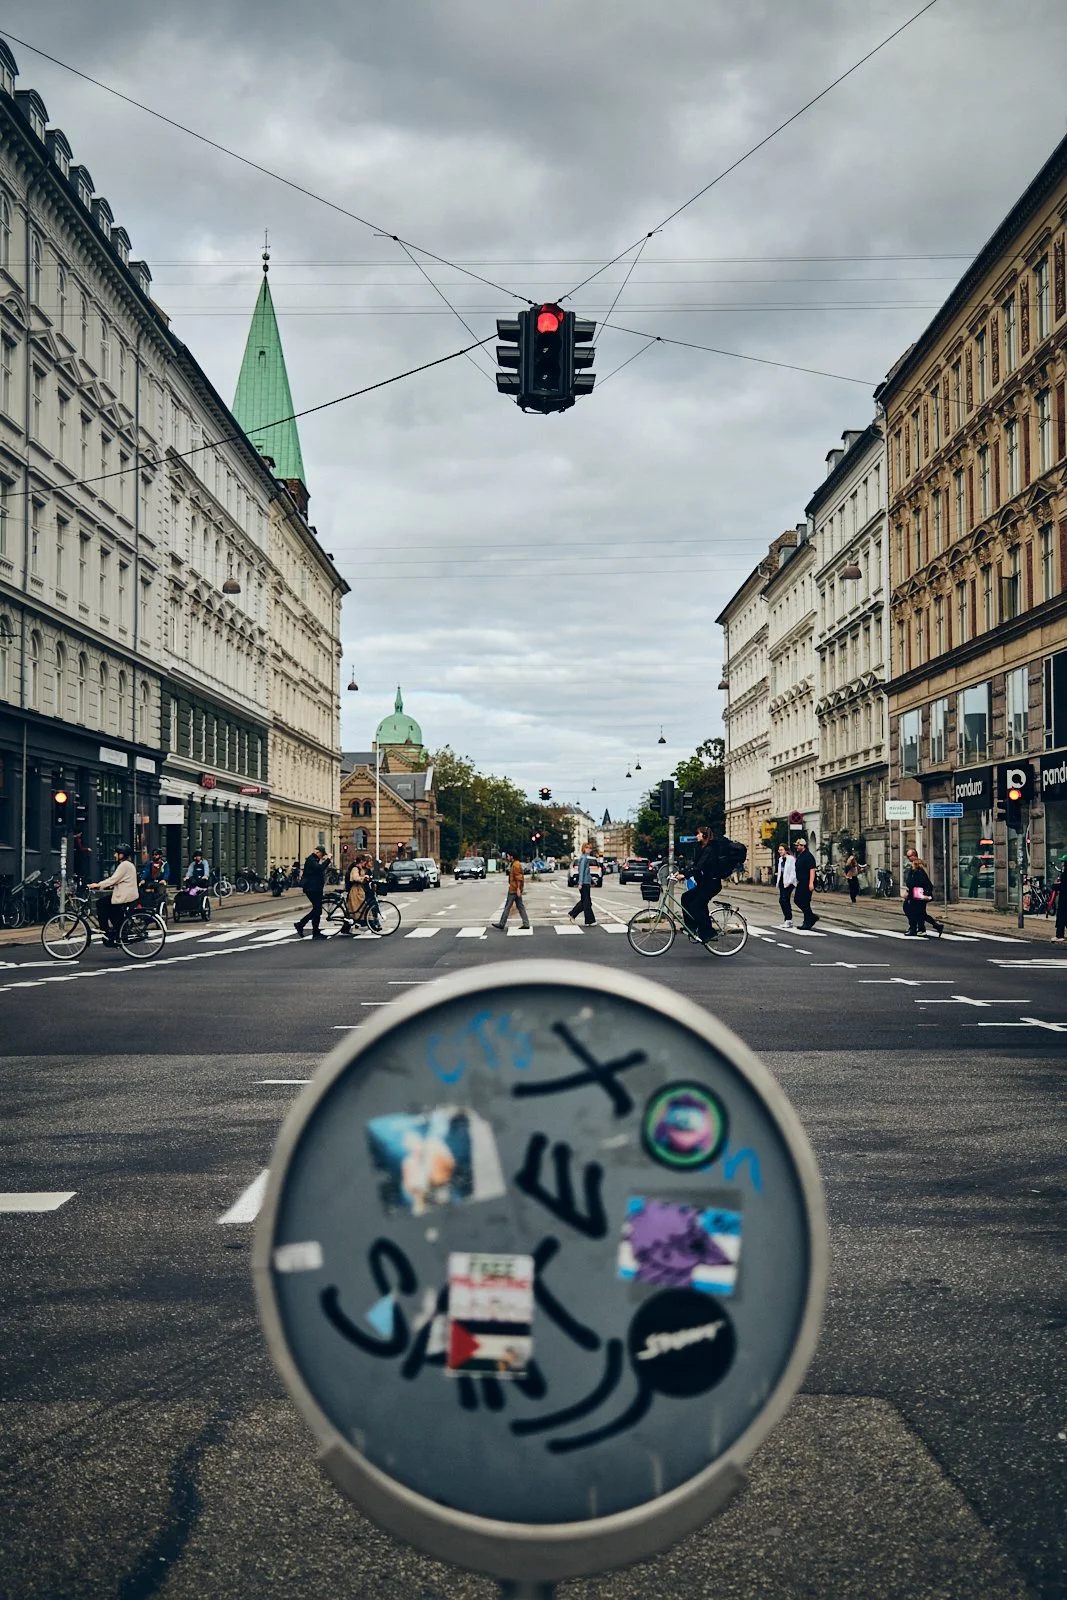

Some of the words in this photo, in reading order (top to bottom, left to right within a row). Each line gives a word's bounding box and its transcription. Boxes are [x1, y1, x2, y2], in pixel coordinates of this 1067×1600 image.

[1043, 761, 1067, 791] pand
[955, 778, 982, 802] panduro
[468, 1254, 516, 1276] FREE
